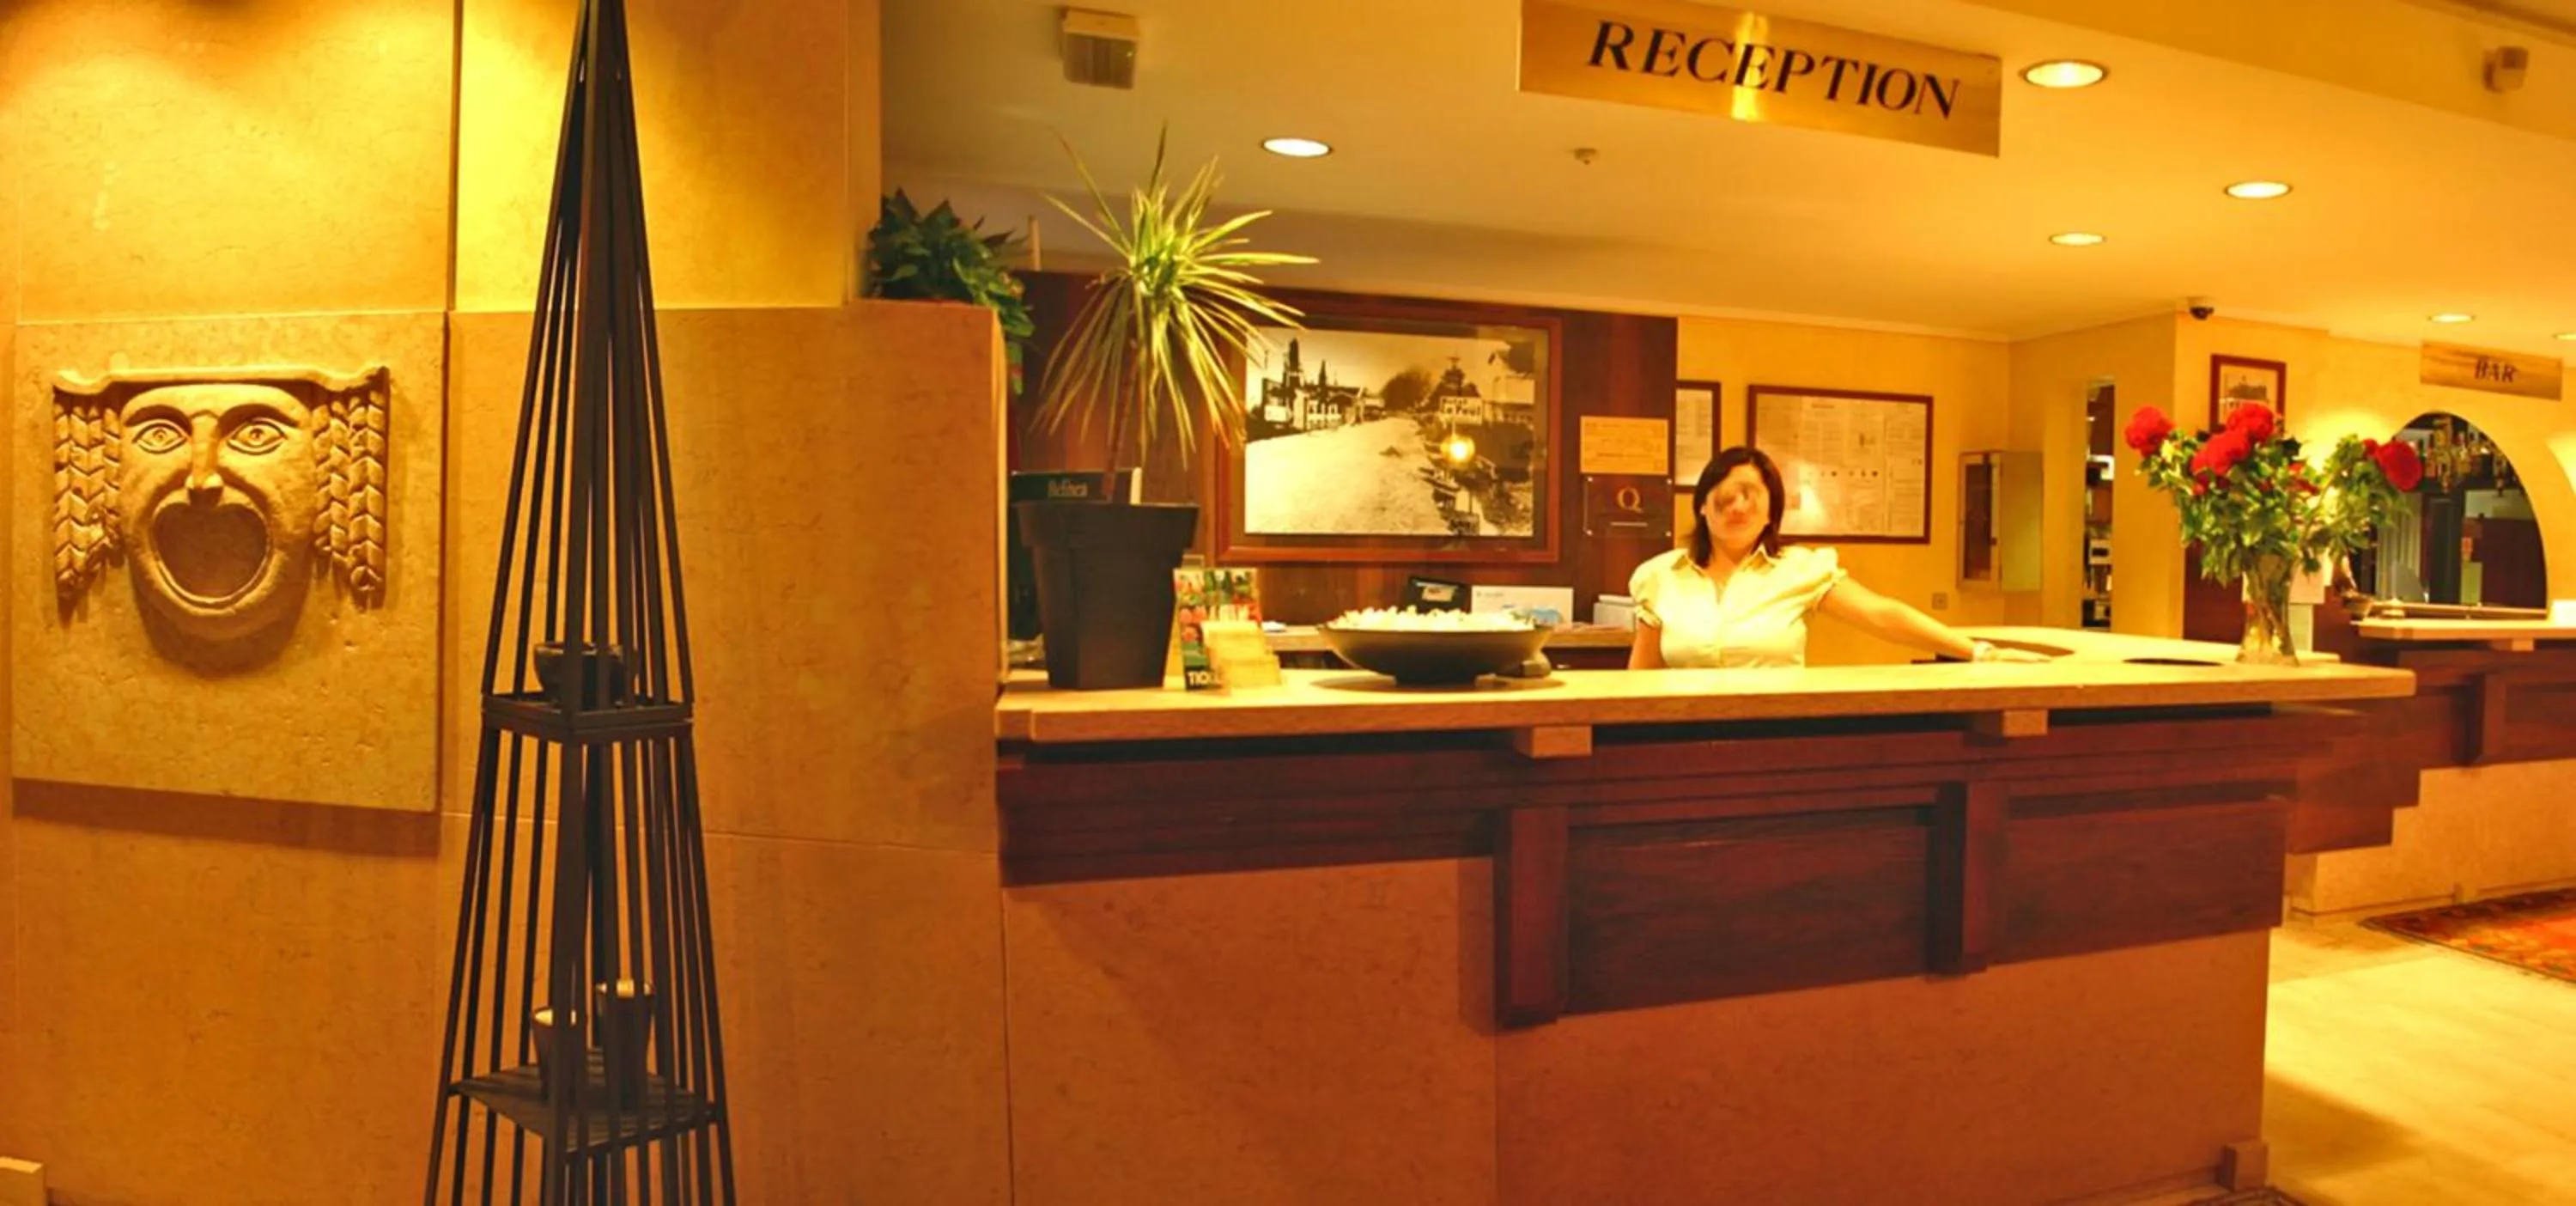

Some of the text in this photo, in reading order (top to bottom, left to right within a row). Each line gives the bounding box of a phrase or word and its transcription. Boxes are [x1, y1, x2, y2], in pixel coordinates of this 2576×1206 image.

[1587, 20, 1961, 120] RECEPTION
[2474, 357, 2518, 383] BAR
[1617, 486, 1643, 513] Q
